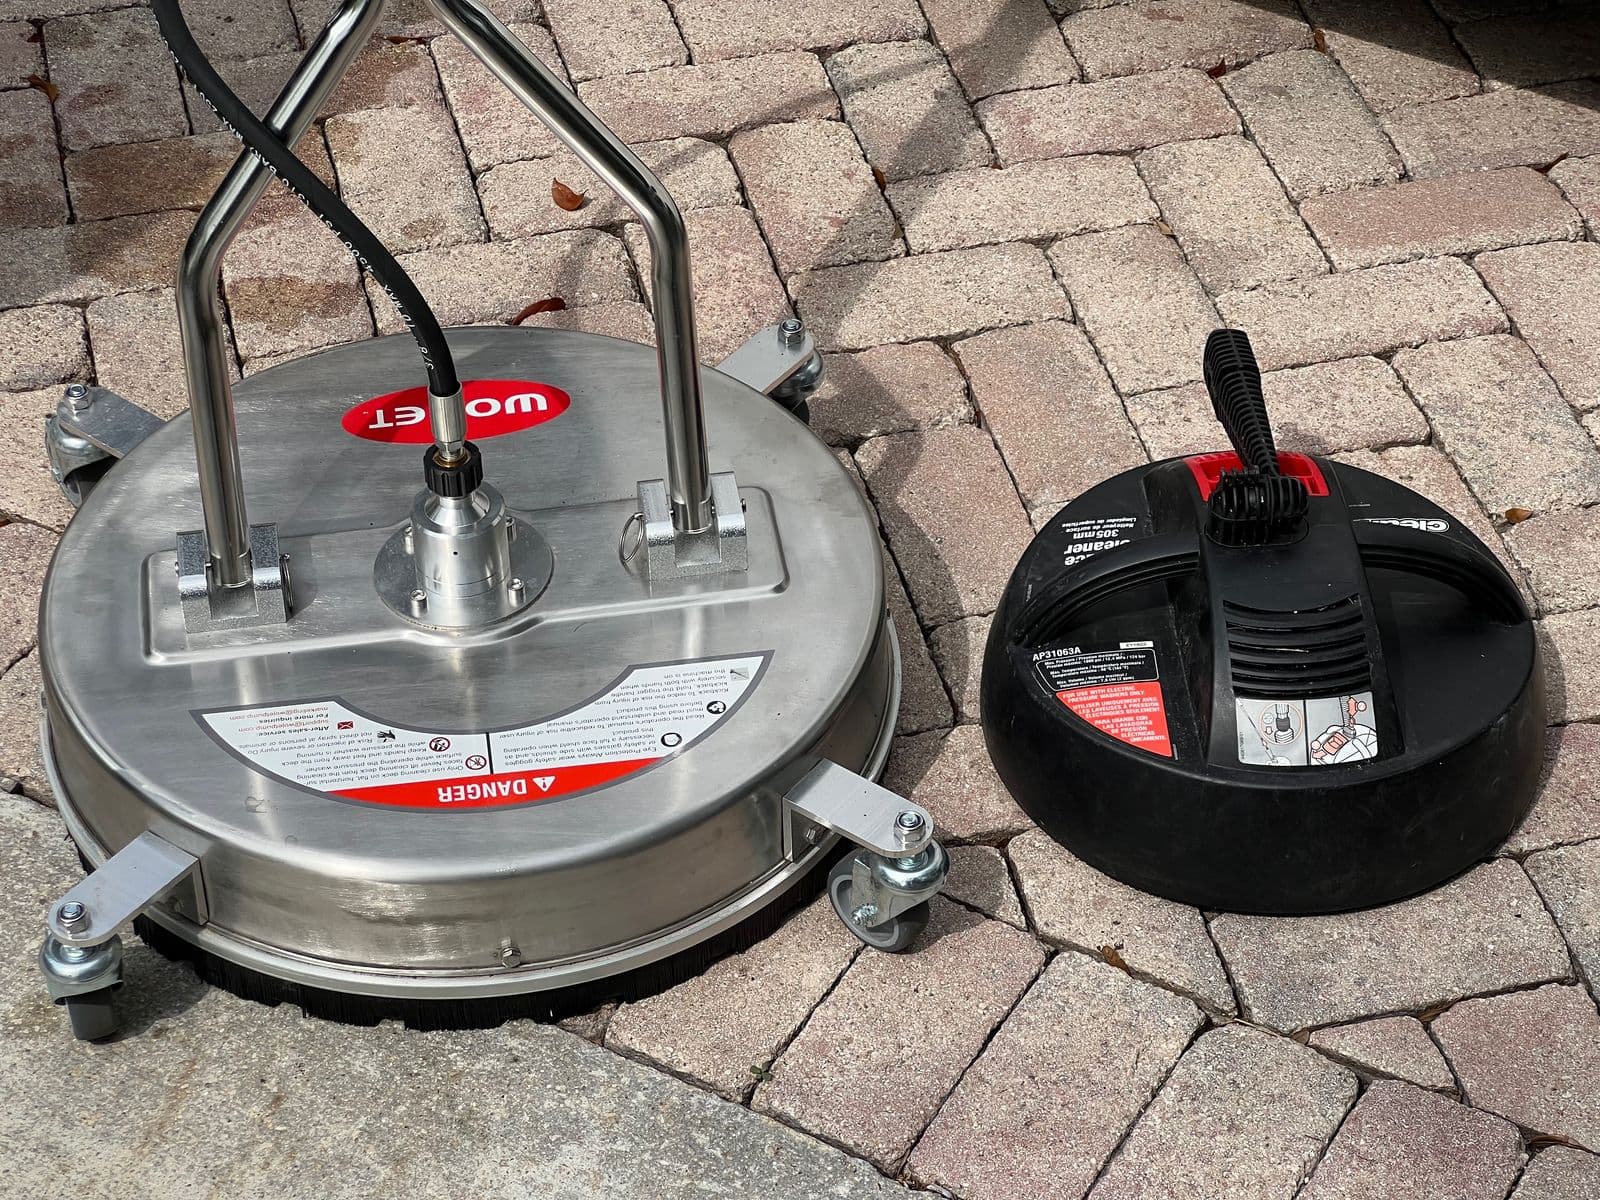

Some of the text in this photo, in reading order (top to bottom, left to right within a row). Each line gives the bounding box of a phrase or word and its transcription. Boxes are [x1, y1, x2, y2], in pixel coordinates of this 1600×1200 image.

[369, 393, 547, 429] WOET
[1032, 647, 1082, 662] AP31063A
[436, 779, 528, 803] DANGER
